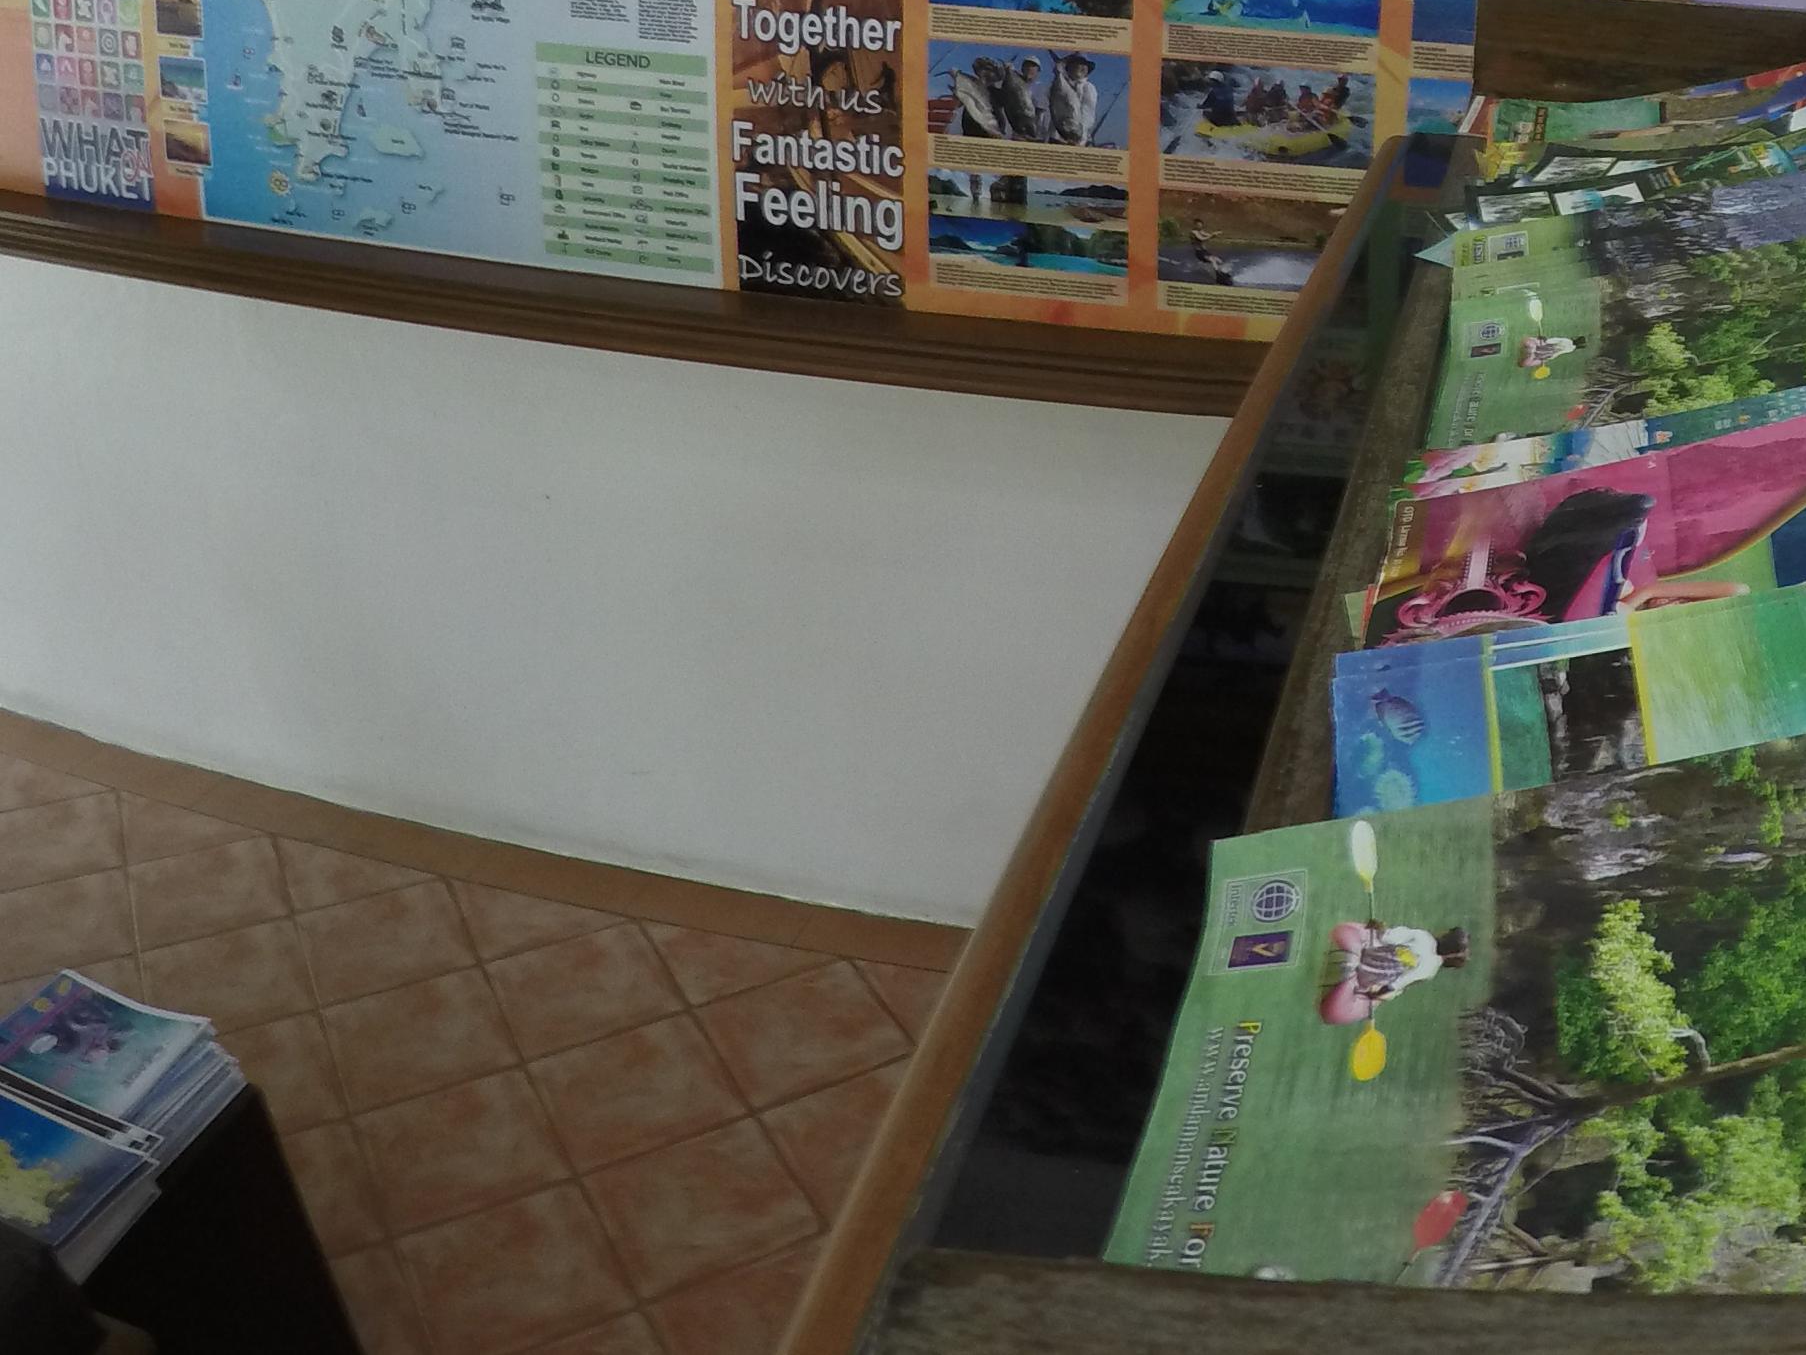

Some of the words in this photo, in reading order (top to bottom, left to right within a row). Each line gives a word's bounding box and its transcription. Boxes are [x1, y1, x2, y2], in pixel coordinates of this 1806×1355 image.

[585, 50, 652, 72] LEGEND
[748, 75, 827, 111] with
[838, 82, 884, 116] us
[39, 116, 150, 164] WHAT
[731, 119, 906, 179] Fantastic
[42, 156, 153, 202] PHUKET
[734, 170, 905, 252] Feeling
[737, 253, 905, 300] Discovers
[1221, 1020, 1262, 1123] Preserve
[1196, 1125, 1240, 1214] Nature
[1180, 1219, 1216, 1270] For
